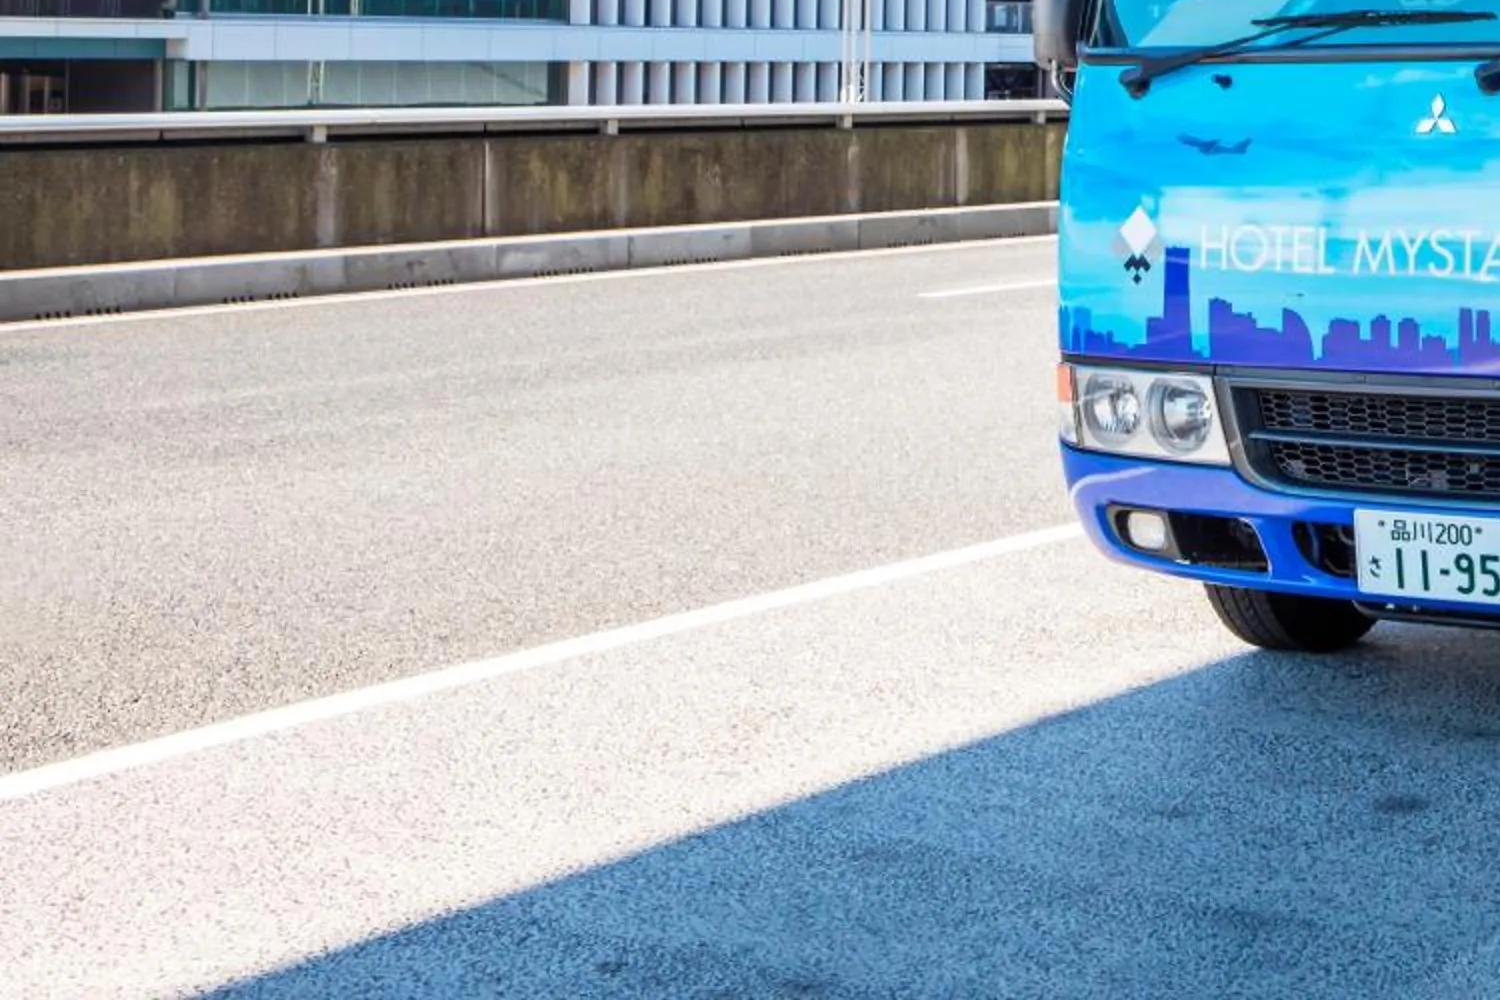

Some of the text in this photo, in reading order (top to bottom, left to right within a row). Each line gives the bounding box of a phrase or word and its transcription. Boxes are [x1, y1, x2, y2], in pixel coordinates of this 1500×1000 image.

[1200, 223, 1335, 275] HOTEL
[1369, 547, 1500, 596] さ 11-95
